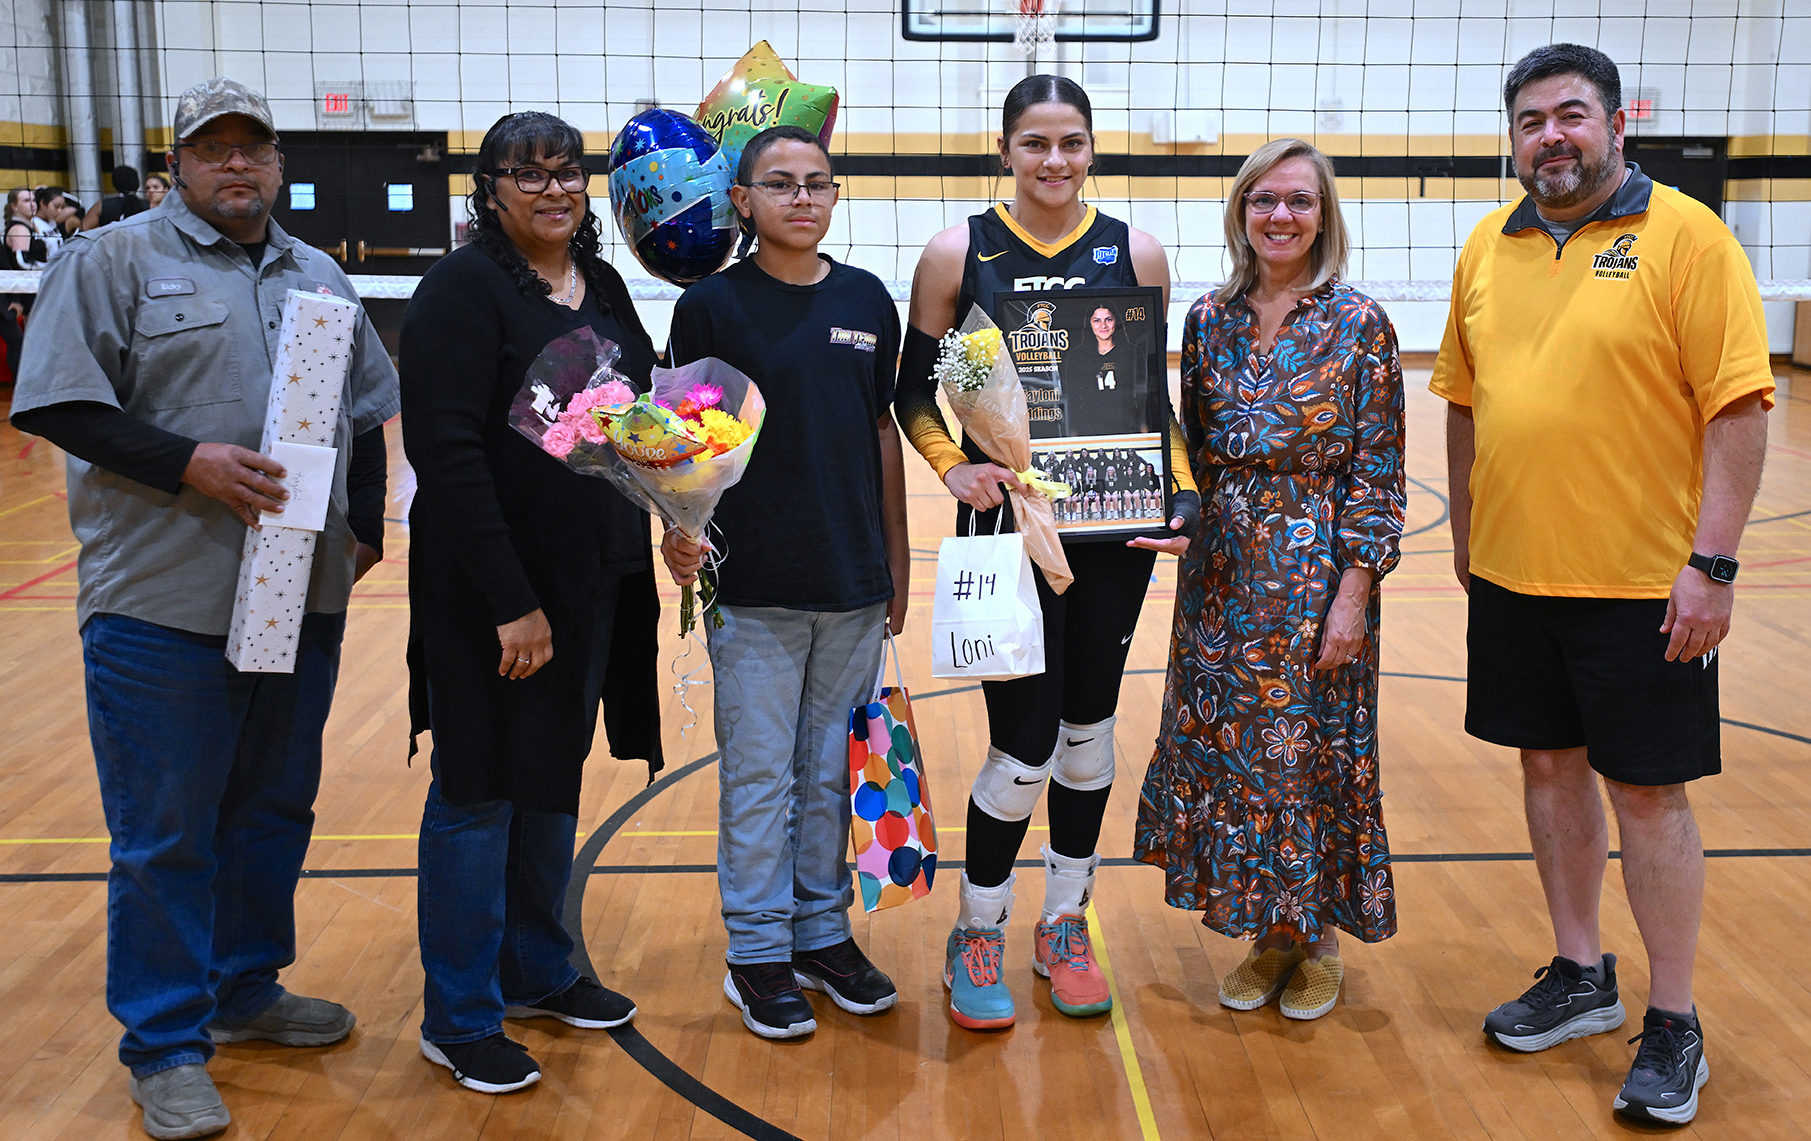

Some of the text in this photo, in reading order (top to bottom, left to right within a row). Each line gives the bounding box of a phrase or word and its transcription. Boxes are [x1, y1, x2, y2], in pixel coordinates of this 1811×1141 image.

[325, 93, 349, 112] EXIT
[701, 88, 790, 145] ngrats!
[1592, 254, 1639, 271] TROJANS
[1595, 270, 1630, 279] VOLLEYBALL
[1125, 306, 1146, 321] #14
[1009, 330, 1069, 352] TROJANS
[1016, 351, 1062, 361] VOLLEYBALL
[1018, 365, 1059, 373] 2025 SEASON
[1025, 388, 1060, 404] ayloni
[953, 570, 996, 601] #14
[951, 631, 995, 668] Loni
